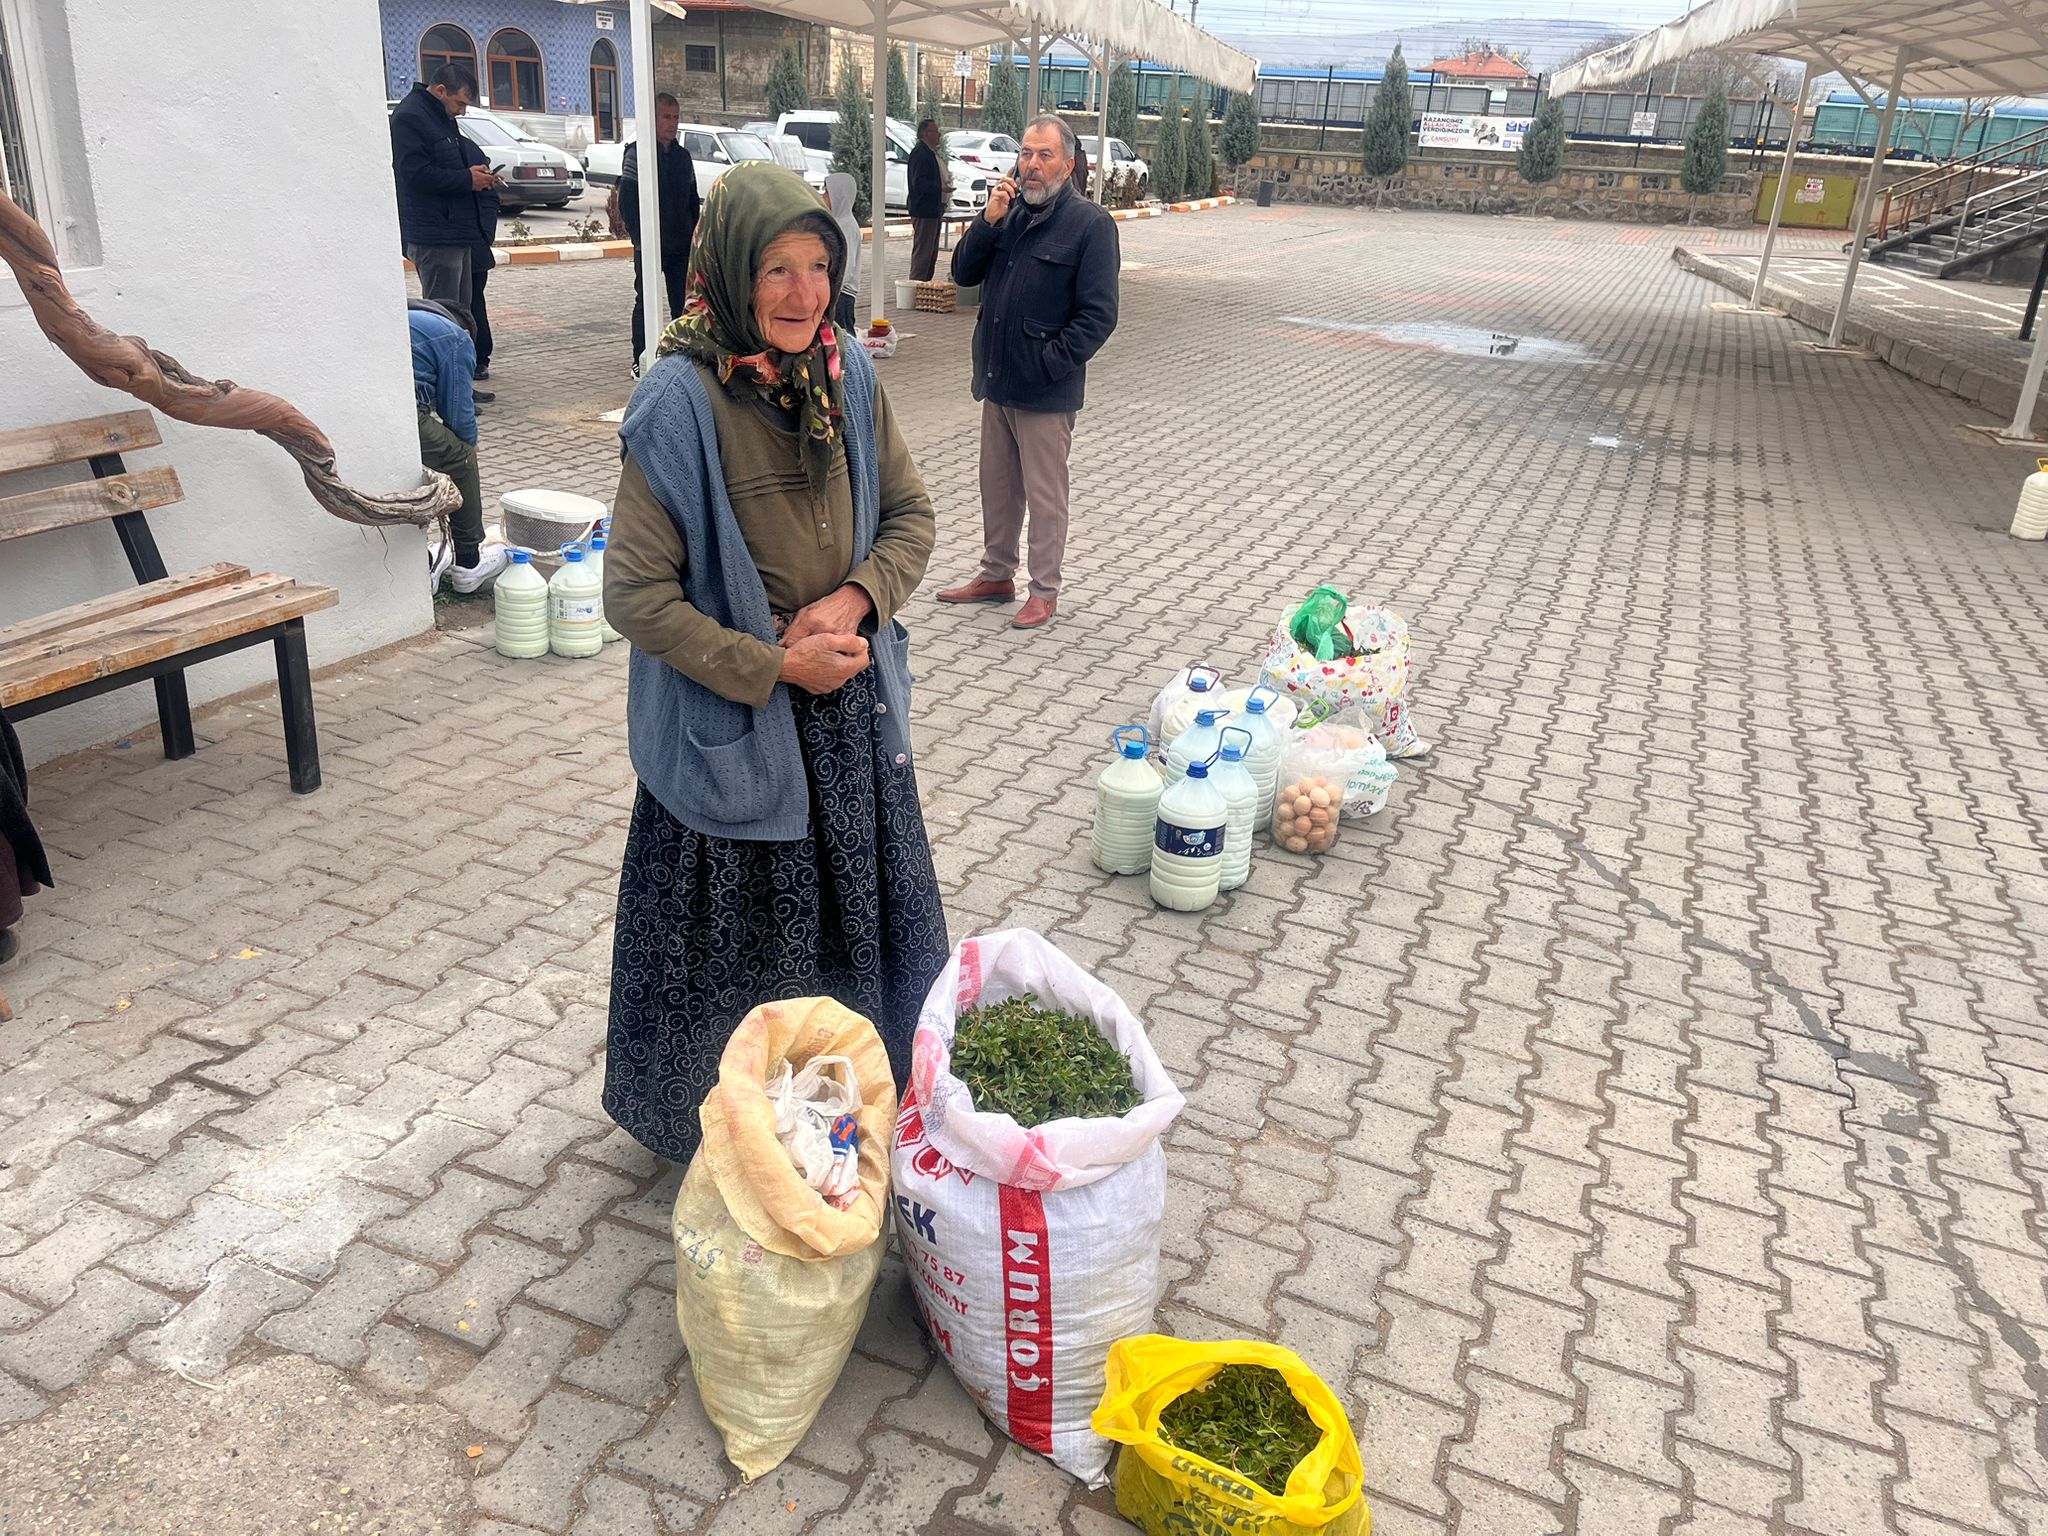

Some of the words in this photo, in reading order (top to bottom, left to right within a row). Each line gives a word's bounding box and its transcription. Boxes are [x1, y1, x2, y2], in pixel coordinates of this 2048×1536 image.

[921, 1249, 939, 1272] 75
[943, 1266, 966, 1287] 87
[1006, 1230, 1050, 1392] ÇORUM
